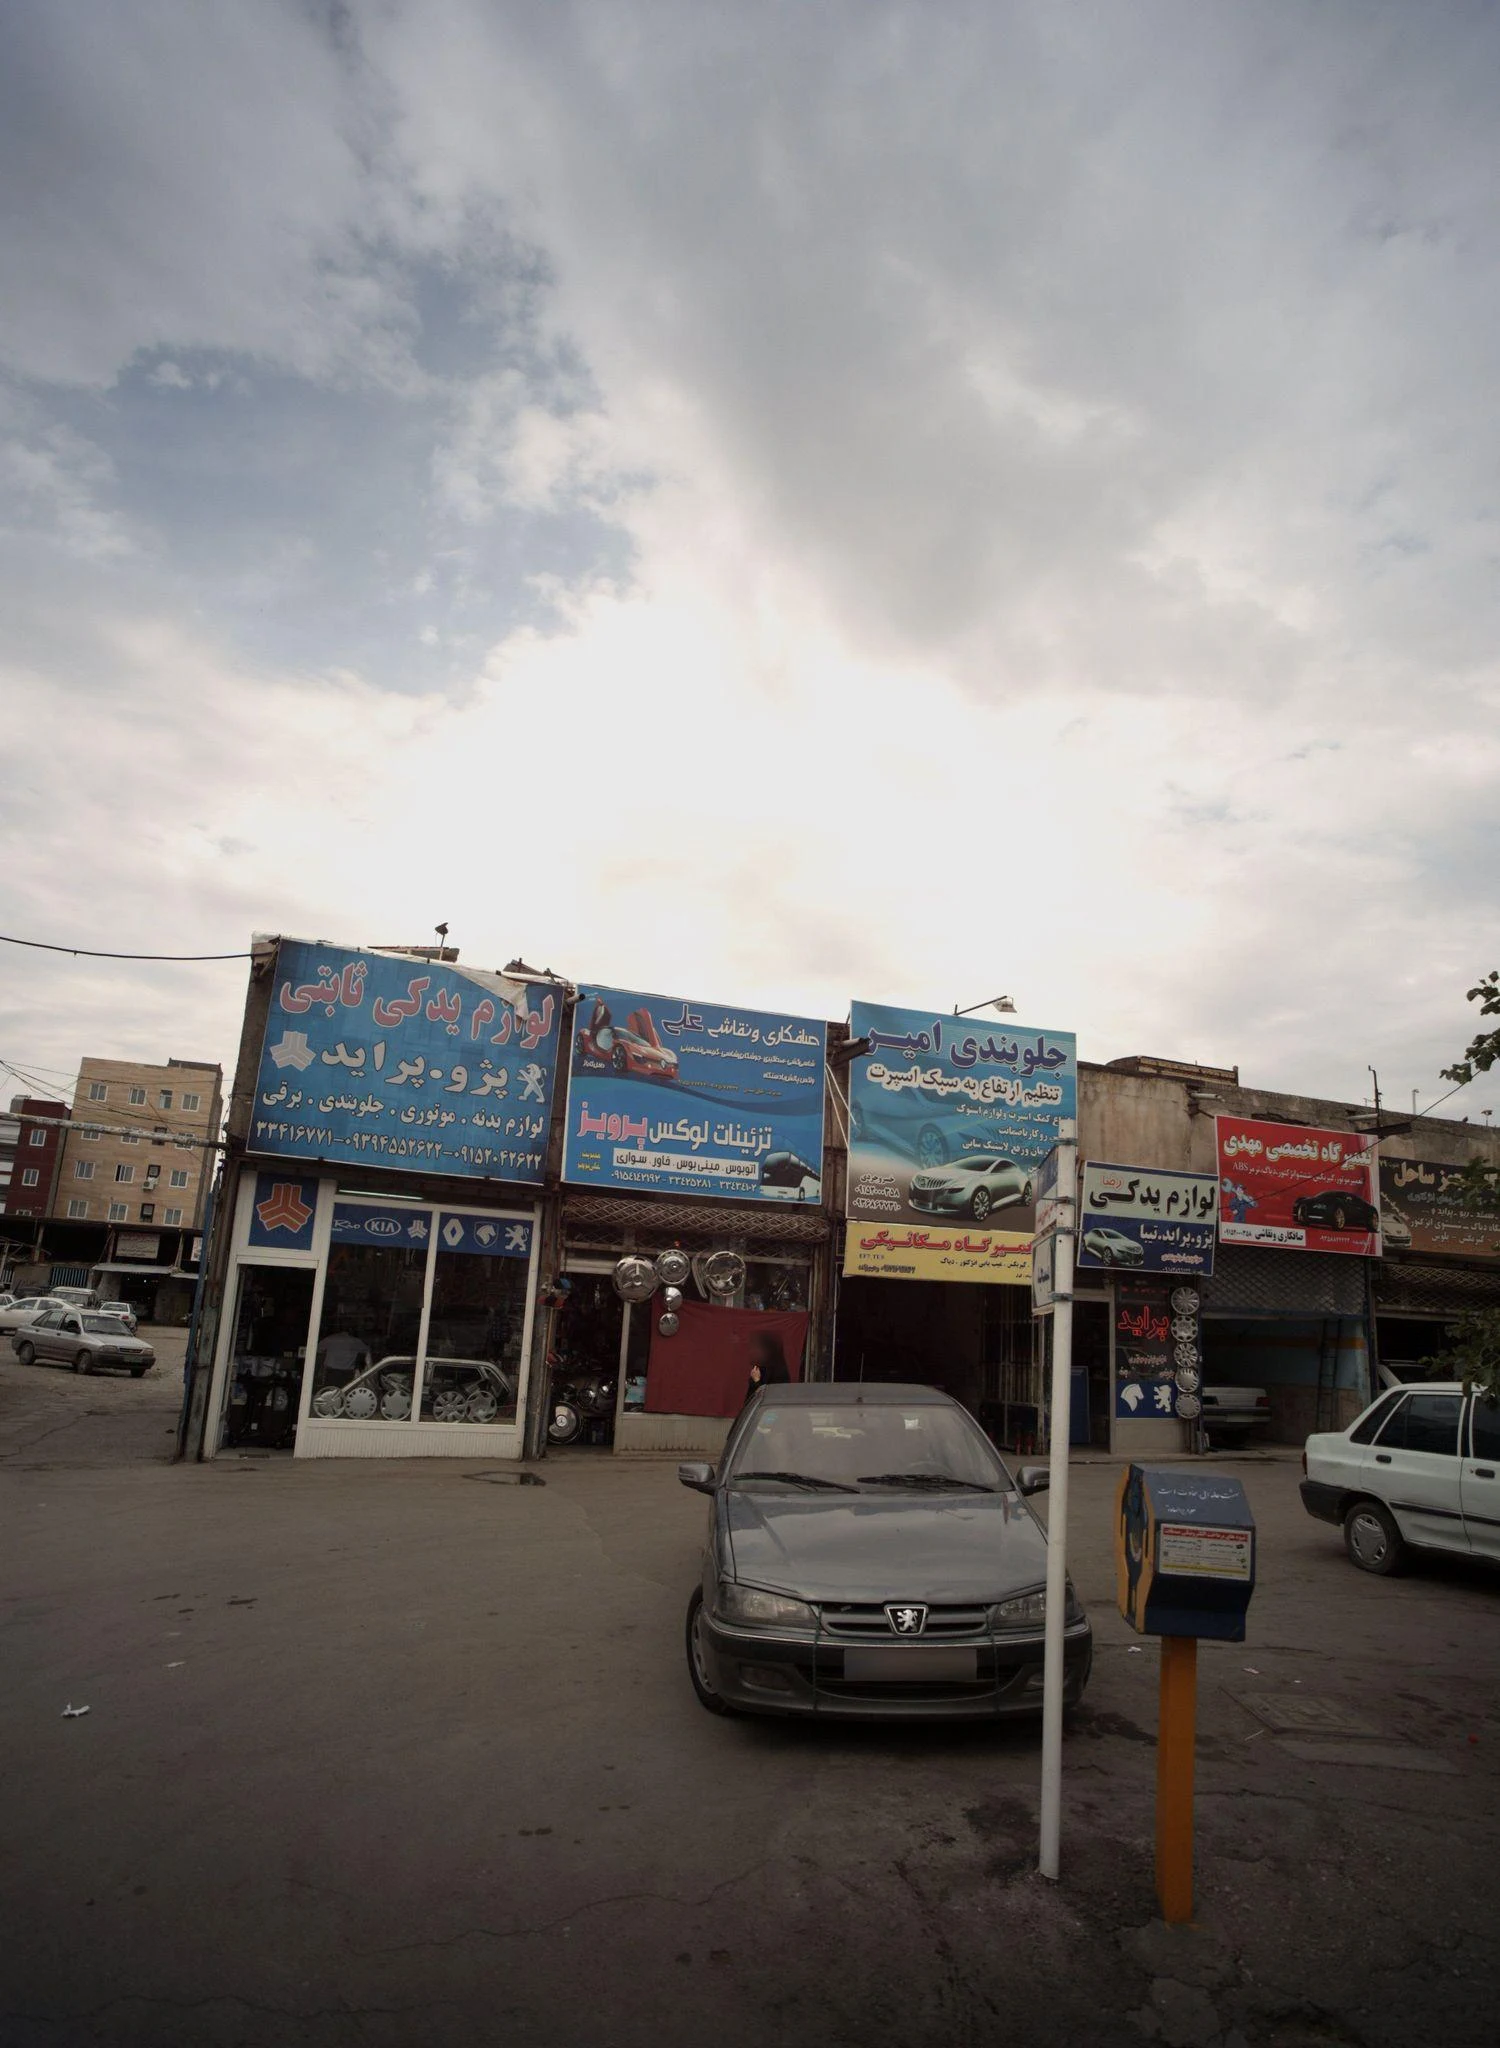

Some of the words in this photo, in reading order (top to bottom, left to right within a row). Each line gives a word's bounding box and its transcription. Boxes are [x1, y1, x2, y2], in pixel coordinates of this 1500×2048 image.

[280, 960, 369, 1017] ثابتی
[373, 976, 461, 1035] یدکی
[865, 1020, 942, 1060] امیر
[949, 1034, 1068, 1080] جلوبندی
[869, 1066, 918, 1087] اسپرت
[922, 1071, 959, 1091] سبک
[963, 1079, 977, 1095] به
[981, 1078, 1020, 1101] ارتفاع
[262, 1080, 303, 1109] برقی
[318, 1092, 384, 1119] جلوبندی
[1023, 1083, 1061, 1103] تنظیم
[401, 1104, 456, 1128] موتوری
[472, 1108, 501, 1134] بدنه
[505, 1114, 544, 1139] لوازم
[577, 1101, 648, 1150] پرویز
[649, 1119, 709, 1150] لوکس
[713, 1122, 773, 1157] تزئینات
[1223, 1134, 1263, 1156] مهدی
[616, 1152, 647, 1164] سواری
[1266, 1138, 1319, 1162] تخصصی
[1102, 1174, 1124, 1189] رضا
[1393, 1161, 1435, 1187] ساحل
[1089, 1178, 1161, 1212] یدکی
[1166, 1185, 1216, 1218] لوازم
[860, 1229, 951, 1251] مکانیکی
[1118, 1304, 1170, 1342] پراید
